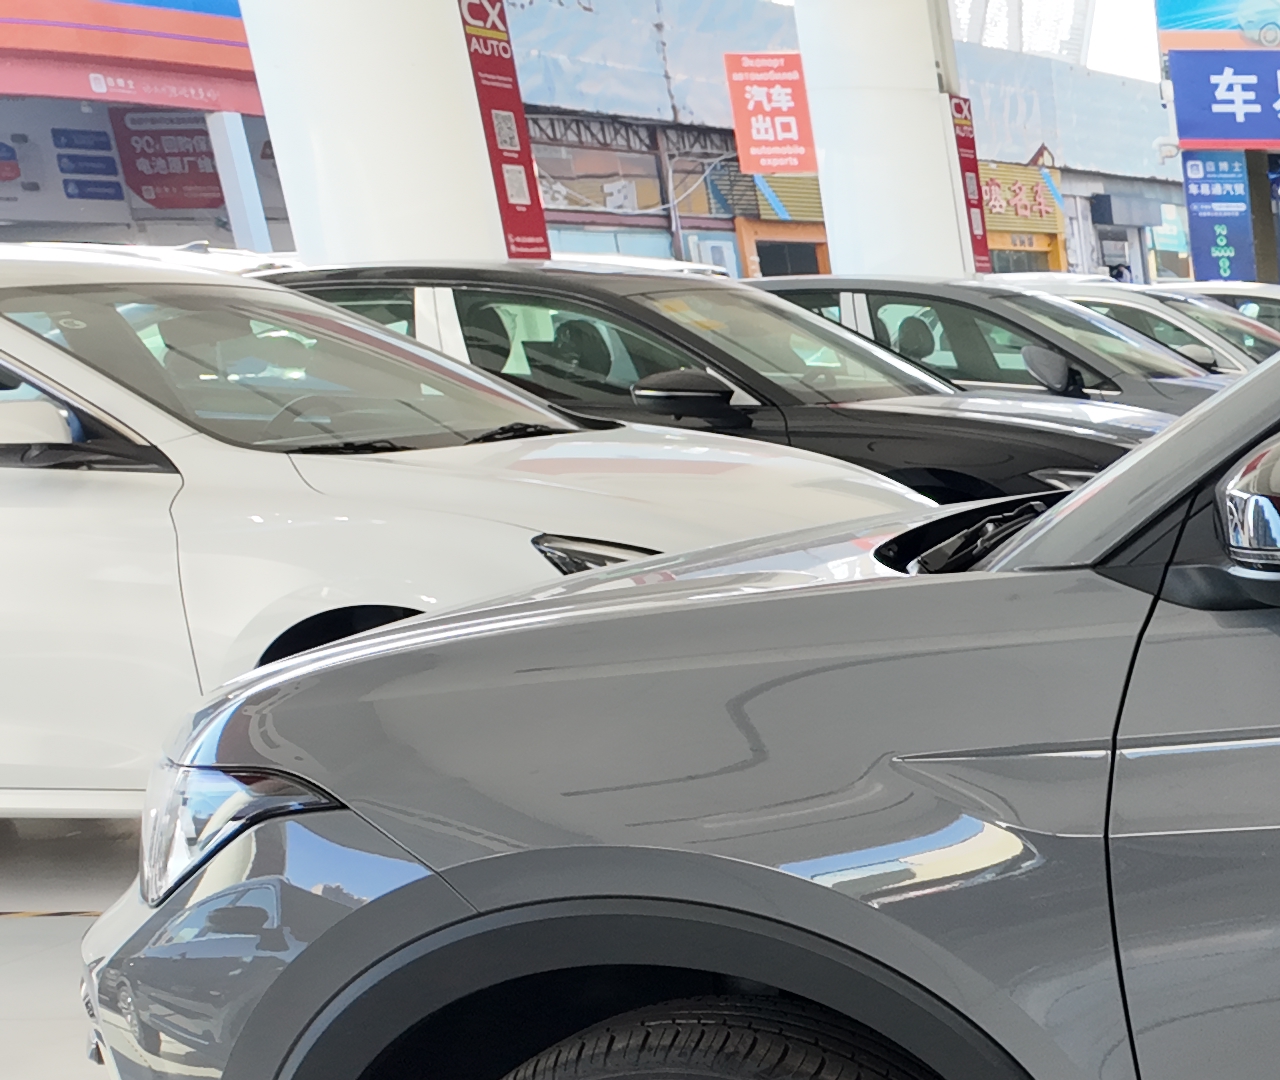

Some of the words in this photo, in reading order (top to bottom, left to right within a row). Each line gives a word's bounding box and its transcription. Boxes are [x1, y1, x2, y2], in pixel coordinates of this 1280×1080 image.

[460, 0, 507, 31] CX
[470, 36, 512, 59] AUTO
[744, 84, 795, 112] 汽车
[951, 98, 971, 120] CX
[750, 114, 799, 141] 出口
[749, 145, 806, 156] automobile
[760, 157, 799, 168] exports
